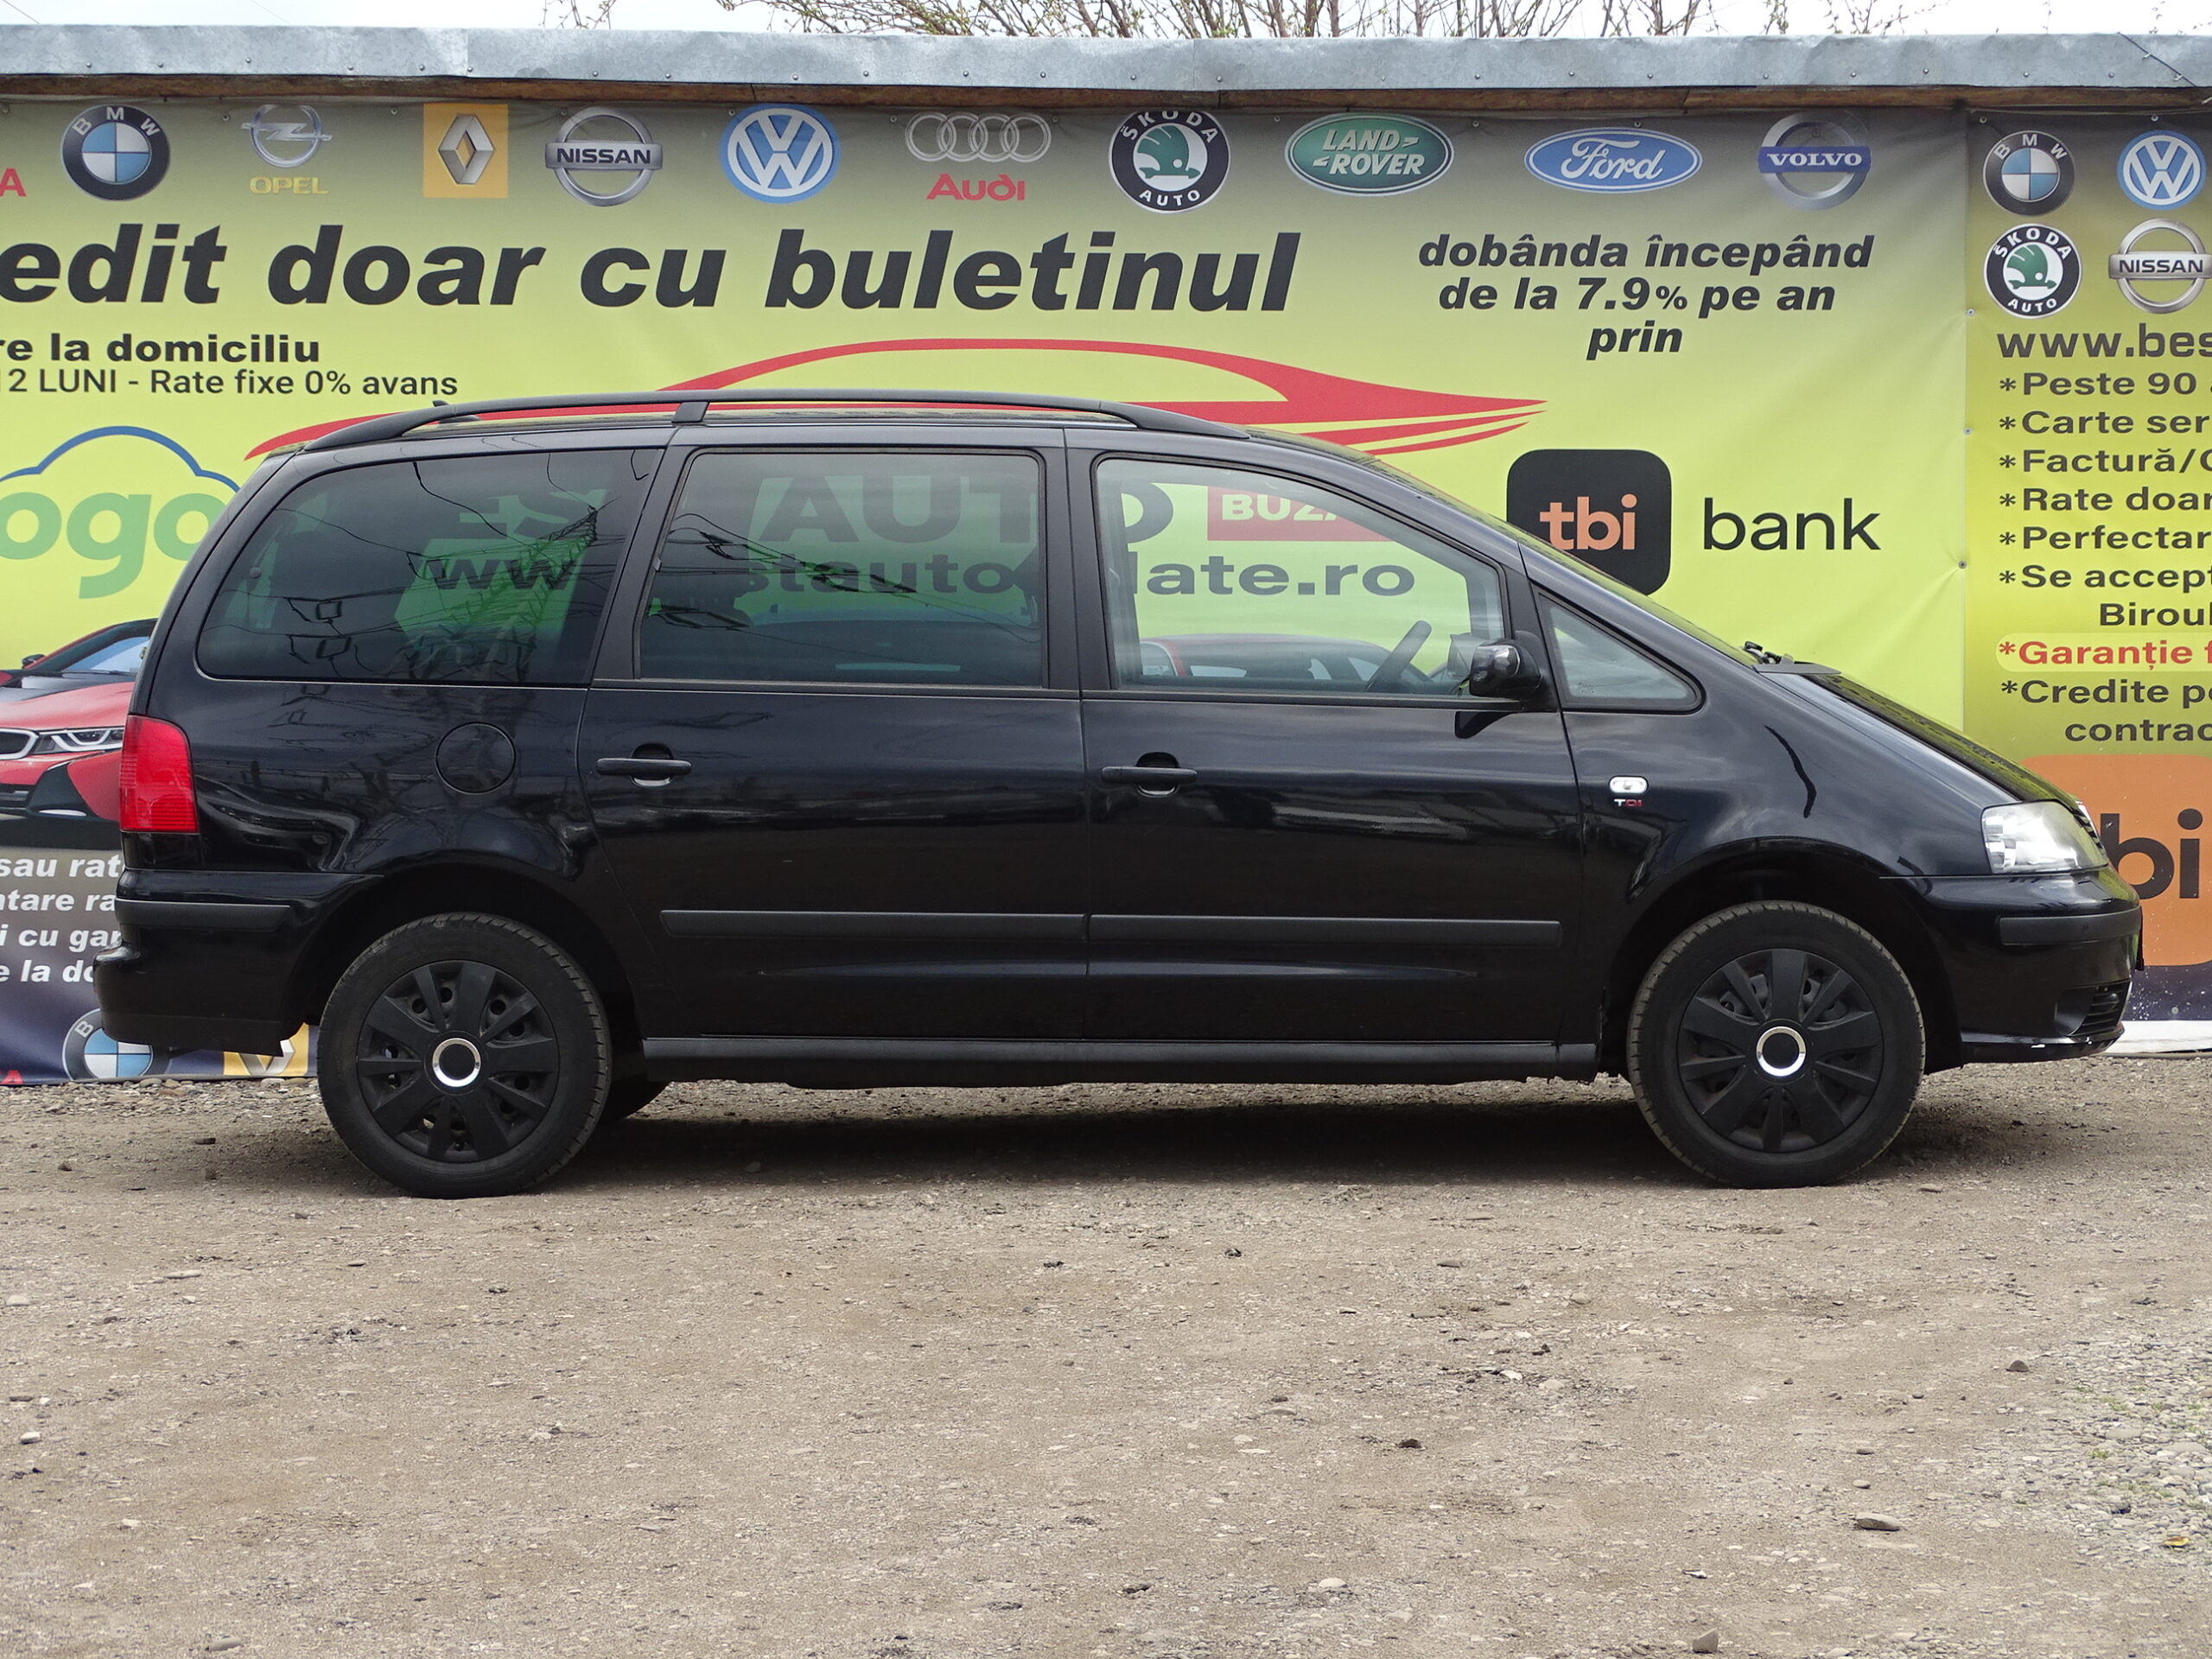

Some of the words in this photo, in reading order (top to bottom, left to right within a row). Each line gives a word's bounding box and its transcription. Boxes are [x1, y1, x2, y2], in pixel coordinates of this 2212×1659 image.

[73, 107, 160, 136] BMW
[1323, 130, 1401, 151] LAND
[1994, 134, 2067, 160] BMW
[557, 148, 651, 165] NISSAN
[1329, 153, 1425, 175] ROVER
[1561, 137, 1667, 180] Ford
[1767, 153, 1862, 167] VOLVO
[250, 176, 328, 195] OPEL
[926, 173, 1026, 201] Audi
[1140, 190, 1201, 207] AUTO
[1419, 234, 1629, 268] dobânda
[1644, 234, 1875, 276] începând
[1993, 227, 2072, 260] ŠKODA
[0, 224, 227, 304] edit
[269, 225, 546, 306] doar
[581, 246, 727, 308] cu
[765, 228, 1301, 312] buletinul
[2119, 259, 2204, 274] NISSAN
[1439, 277, 1498, 310] de
[1513, 277, 1558, 310] la
[1698, 285, 1761, 320] pe
[1777, 285, 1836, 311] an
[2008, 297, 2057, 314] AUTO
[0, 339, 34, 362] e
[51, 333, 90, 361] la
[107, 334, 319, 363] domiciliu
[1586, 320, 1683, 361] prin
[40, 368, 116, 393] LUNI
[151, 369, 225, 394] Rate
[234, 368, 295, 394] fixe
[305, 370, 352, 395] 0%
[362, 376, 458, 396] avans
[2147, 372, 2197, 396] 90
[2146, 414, 2210, 434] ser
[1222, 493, 1337, 521] BUZ
[1538, 493, 1639, 550] tbi
[1702, 497, 1882, 550] bank
[2183, 683, 2212, 709] p
[2064, 719, 2212, 742] contrac
[1613, 798, 1643, 808] TDI
[0, 857, 57, 878] sau
[69, 854, 125, 878] rat
[2100, 808, 2203, 900] bi
[18, 928, 59, 947] cu
[21, 959, 51, 982] la
